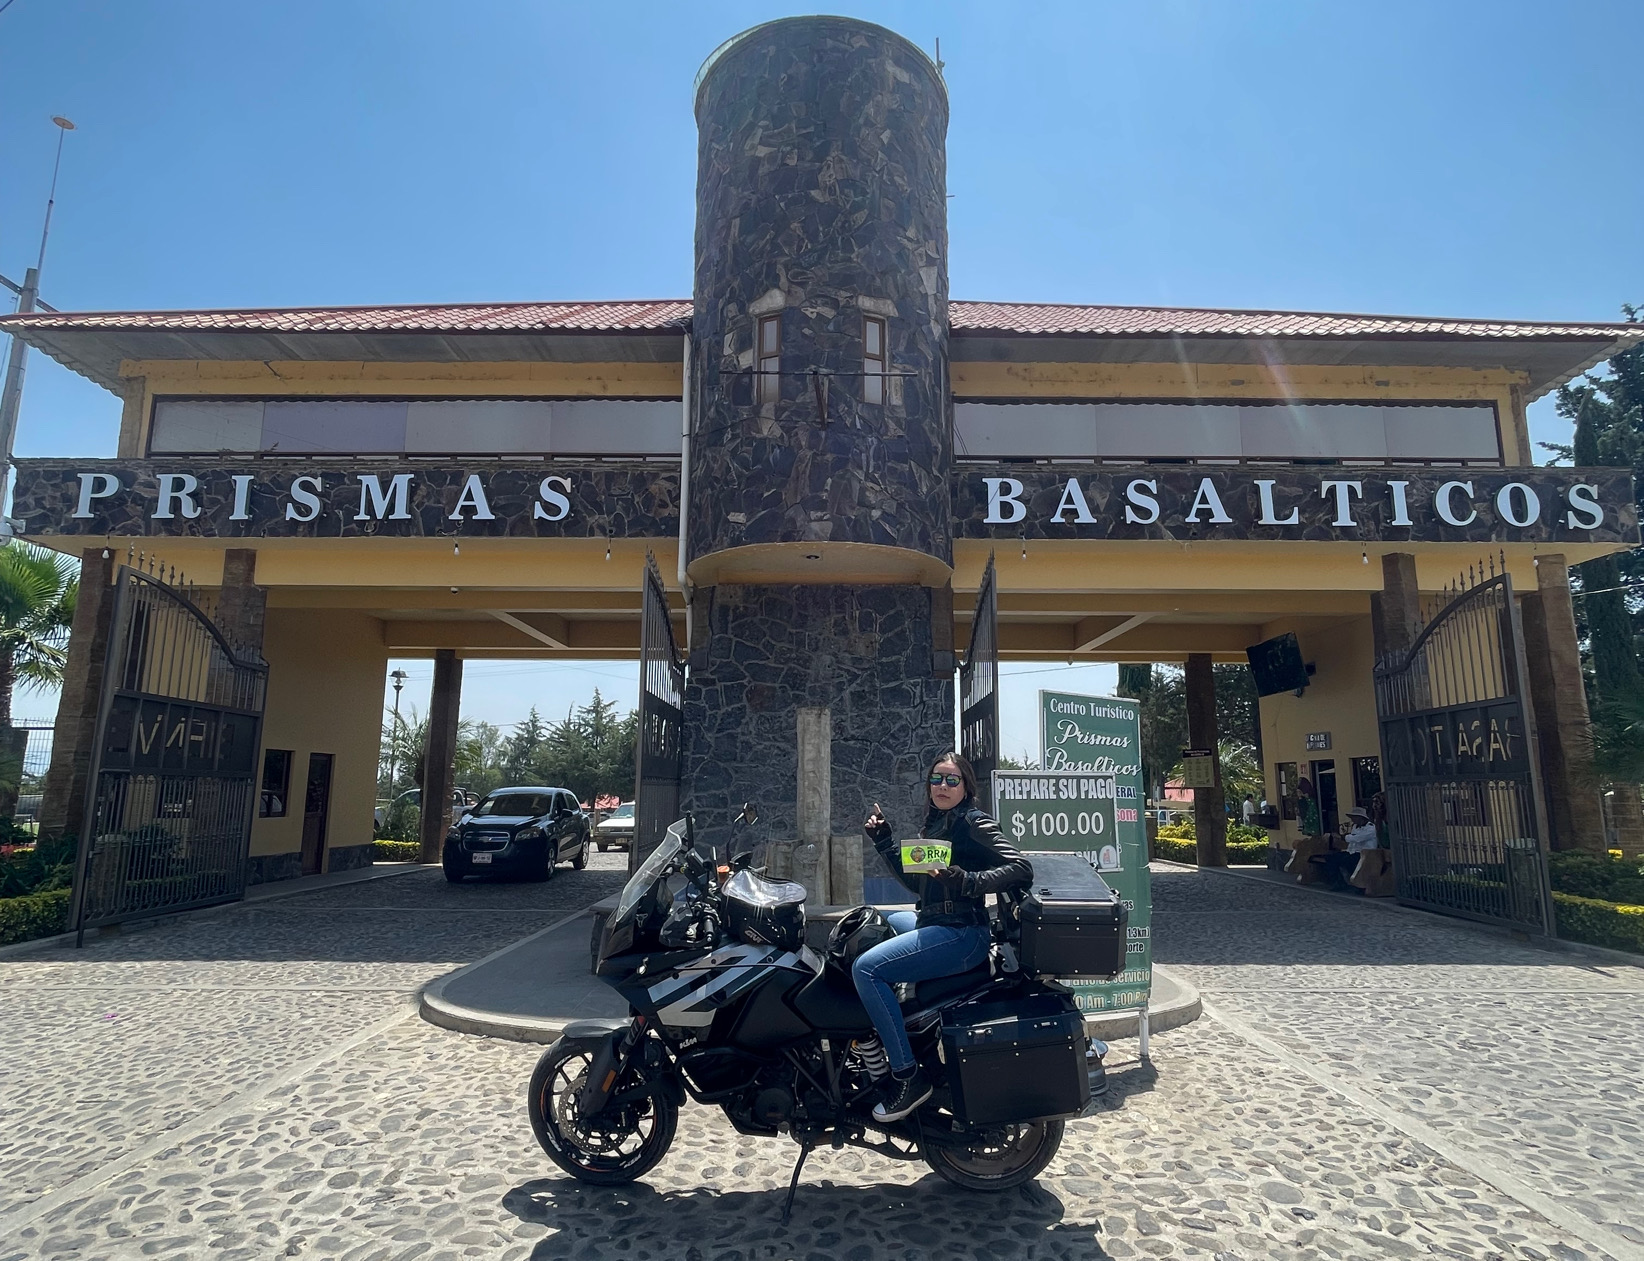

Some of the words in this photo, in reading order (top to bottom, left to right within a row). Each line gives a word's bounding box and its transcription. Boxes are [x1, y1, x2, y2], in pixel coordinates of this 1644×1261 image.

[72, 472, 573, 522] PRISMAS
[981, 476, 1604, 530] BASALTICOS
[1050, 698, 1086, 716] Centro
[1054, 719, 1132, 748] Prismas
[1046, 746, 1142, 776] Basalticos
[997, 778, 1057, 800] PREPARE
[1058, 778, 1078, 800] SU
[1080, 778, 1114, 800] PAGO
[1011, 810, 1104, 842] $100.00
[1126, 942, 1145, 954] orte
[1087, 993, 1105, 1010] Am
[1112, 991, 1133, 1007] 7:00
